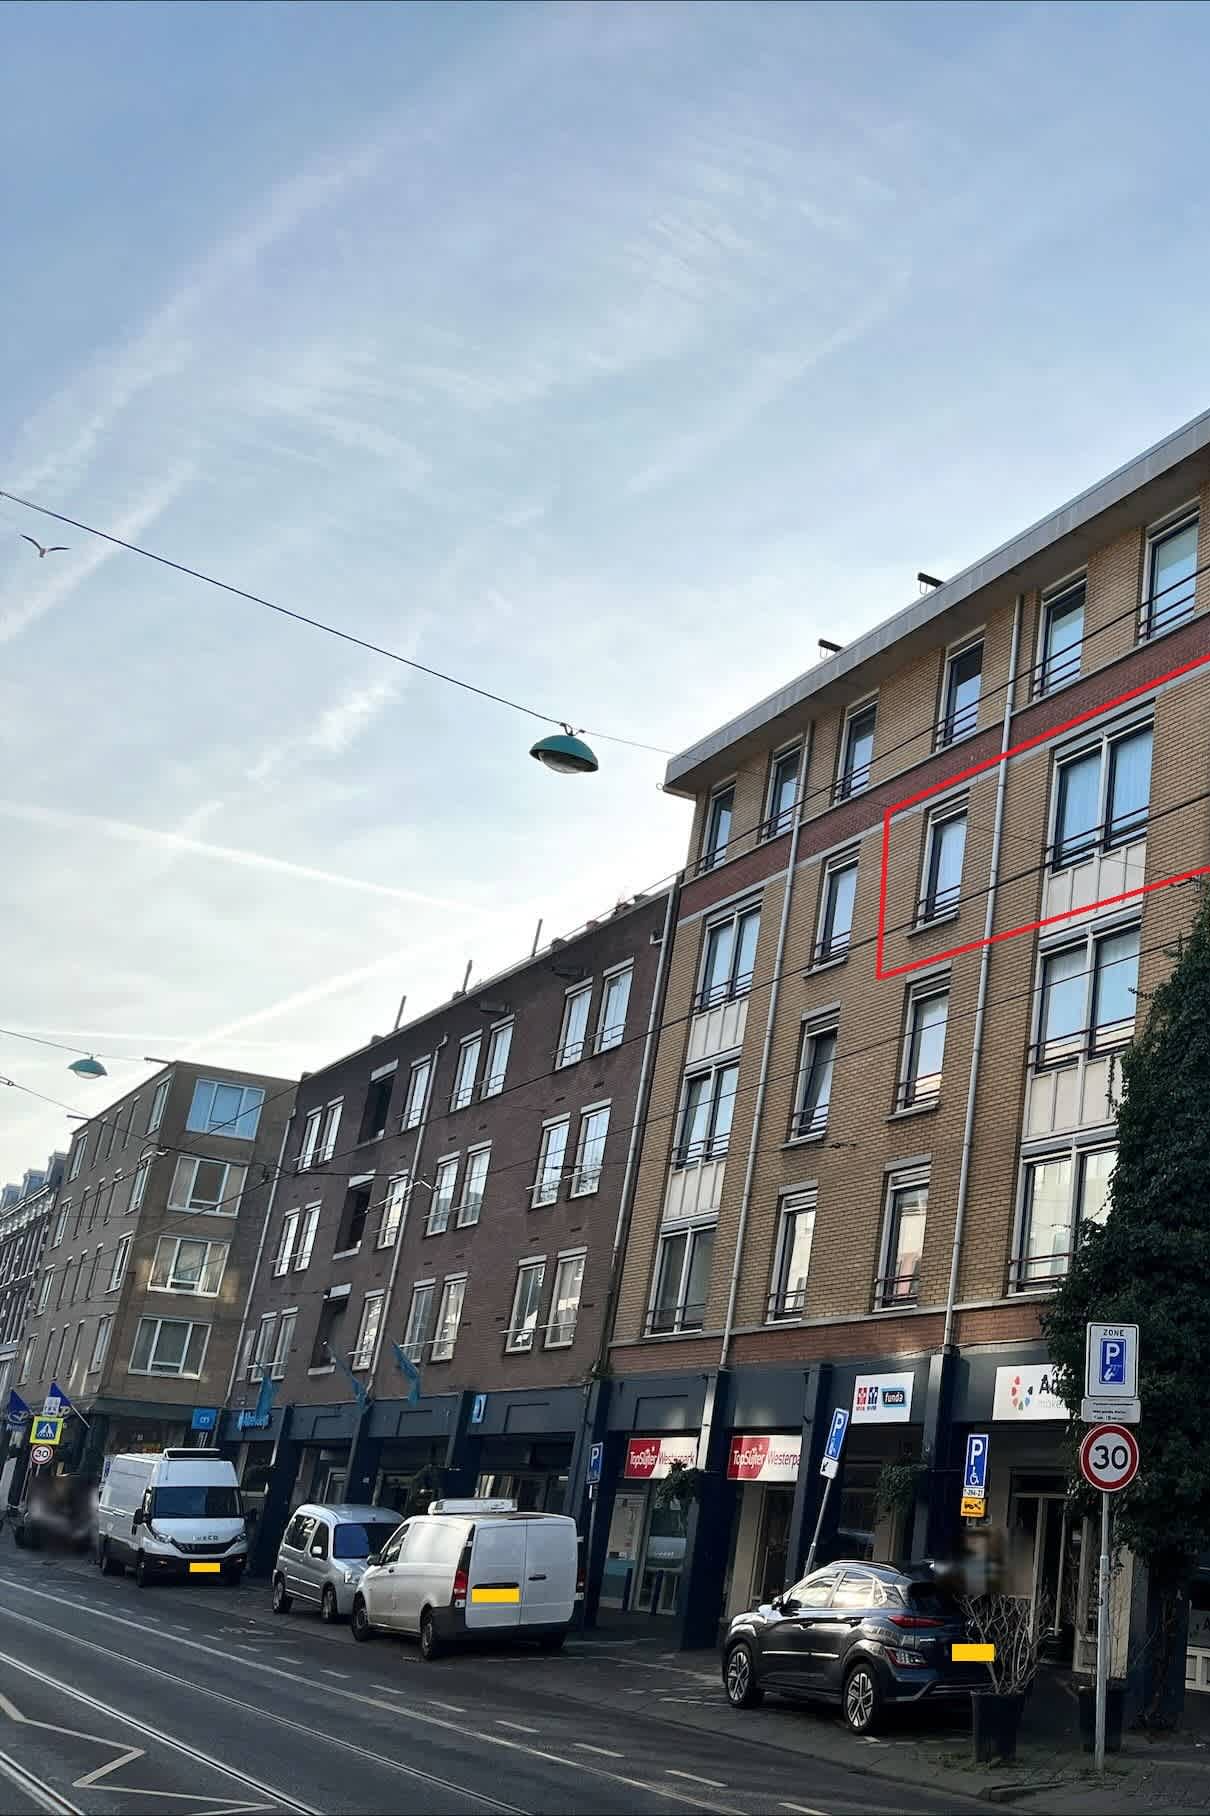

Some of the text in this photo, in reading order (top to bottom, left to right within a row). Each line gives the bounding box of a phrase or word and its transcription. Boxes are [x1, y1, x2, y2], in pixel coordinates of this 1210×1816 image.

[1103, 1328, 1125, 1337] ZONE
[1105, 1343, 1120, 1365] P
[884, 1391, 904, 1403] funda
[832, 1413, 844, 1437] P
[35, 1450, 49, 1458] 30
[590, 1447, 599, 1468] P
[767, 1451, 801, 1468] Westerpa
[971, 1439, 984, 1466] P
[1093, 1445, 1129, 1470] 30
